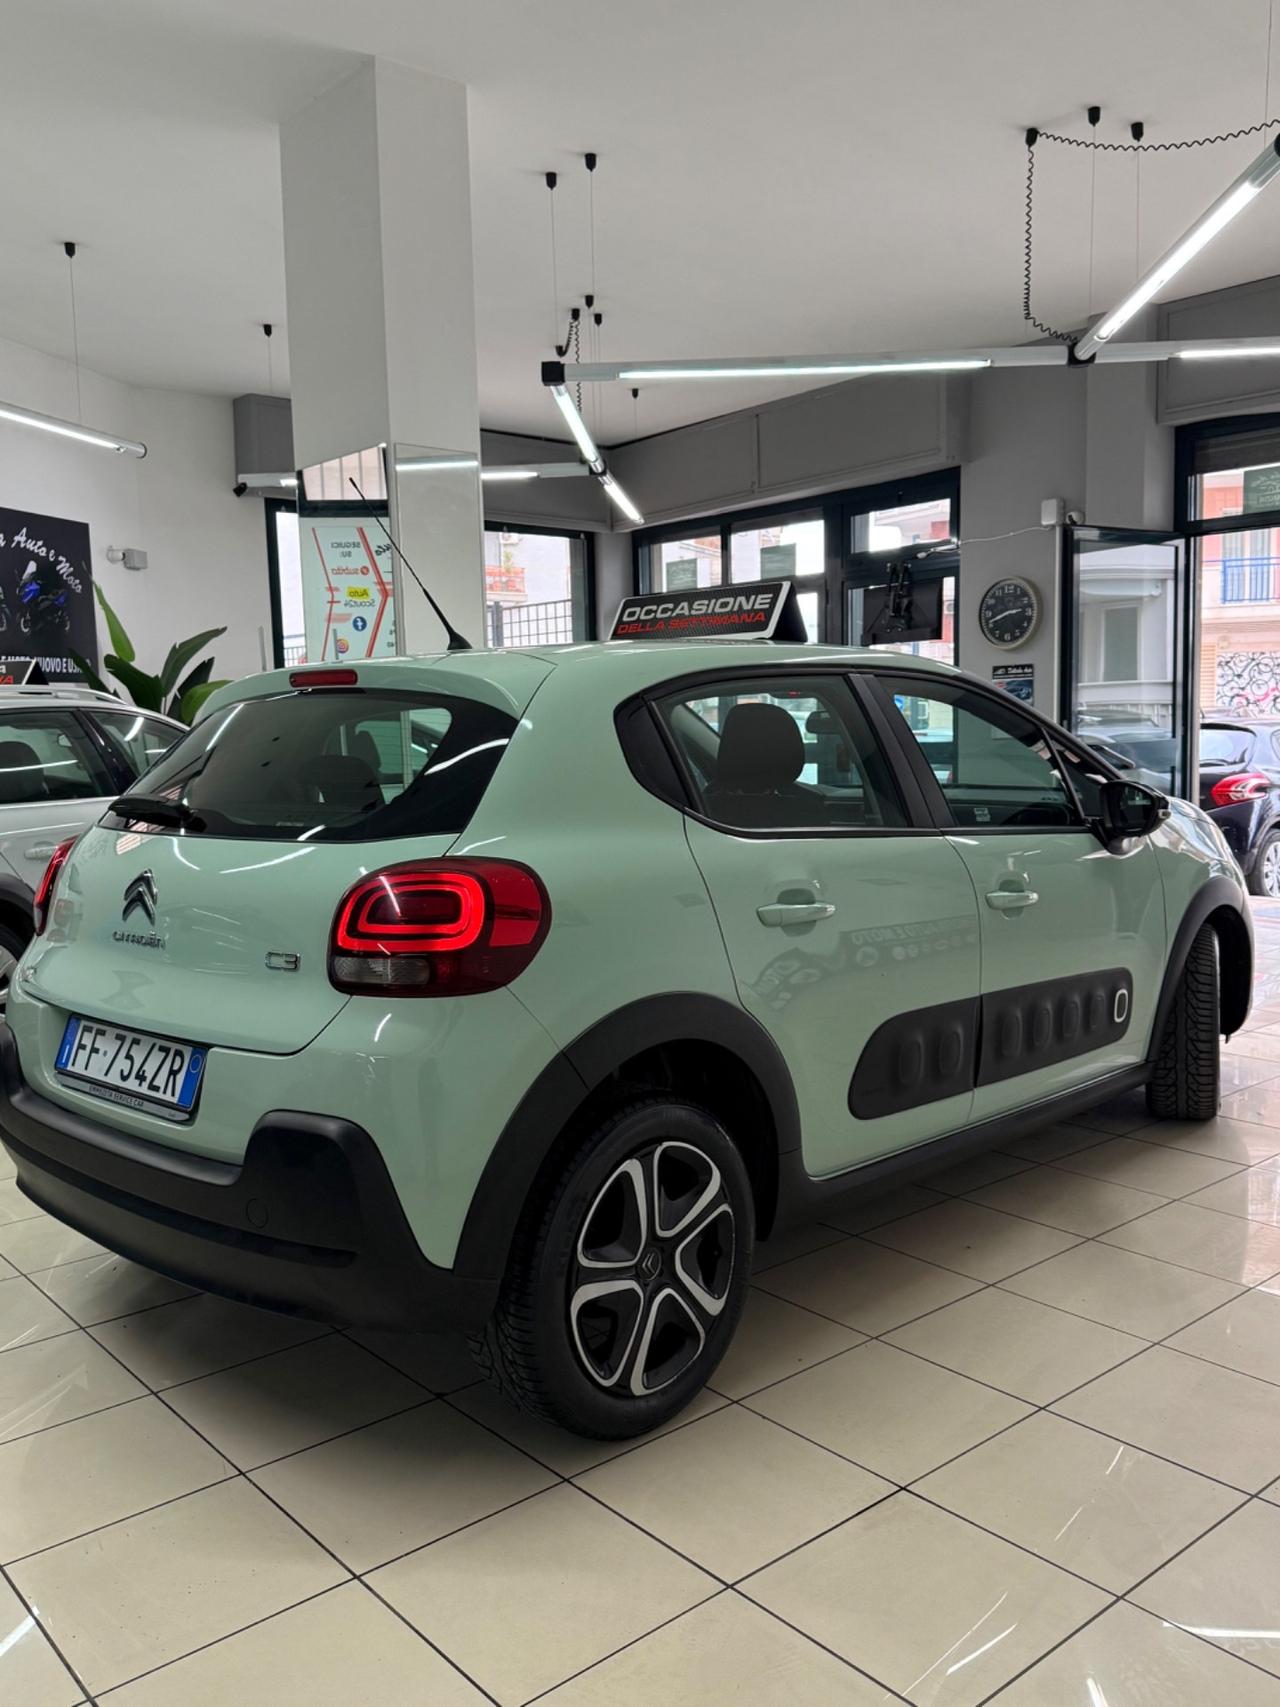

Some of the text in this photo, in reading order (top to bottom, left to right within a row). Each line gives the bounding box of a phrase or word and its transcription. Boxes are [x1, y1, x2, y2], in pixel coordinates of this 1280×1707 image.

[10, 526, 47, 557] Auto
[48, 549, 56, 562] e
[55, 555, 83, 594] Moto
[622, 593, 773, 622] OCCASIONE
[617, 612, 766, 635] DELLA SETTIMANA
[62, 657, 67, 673] E
